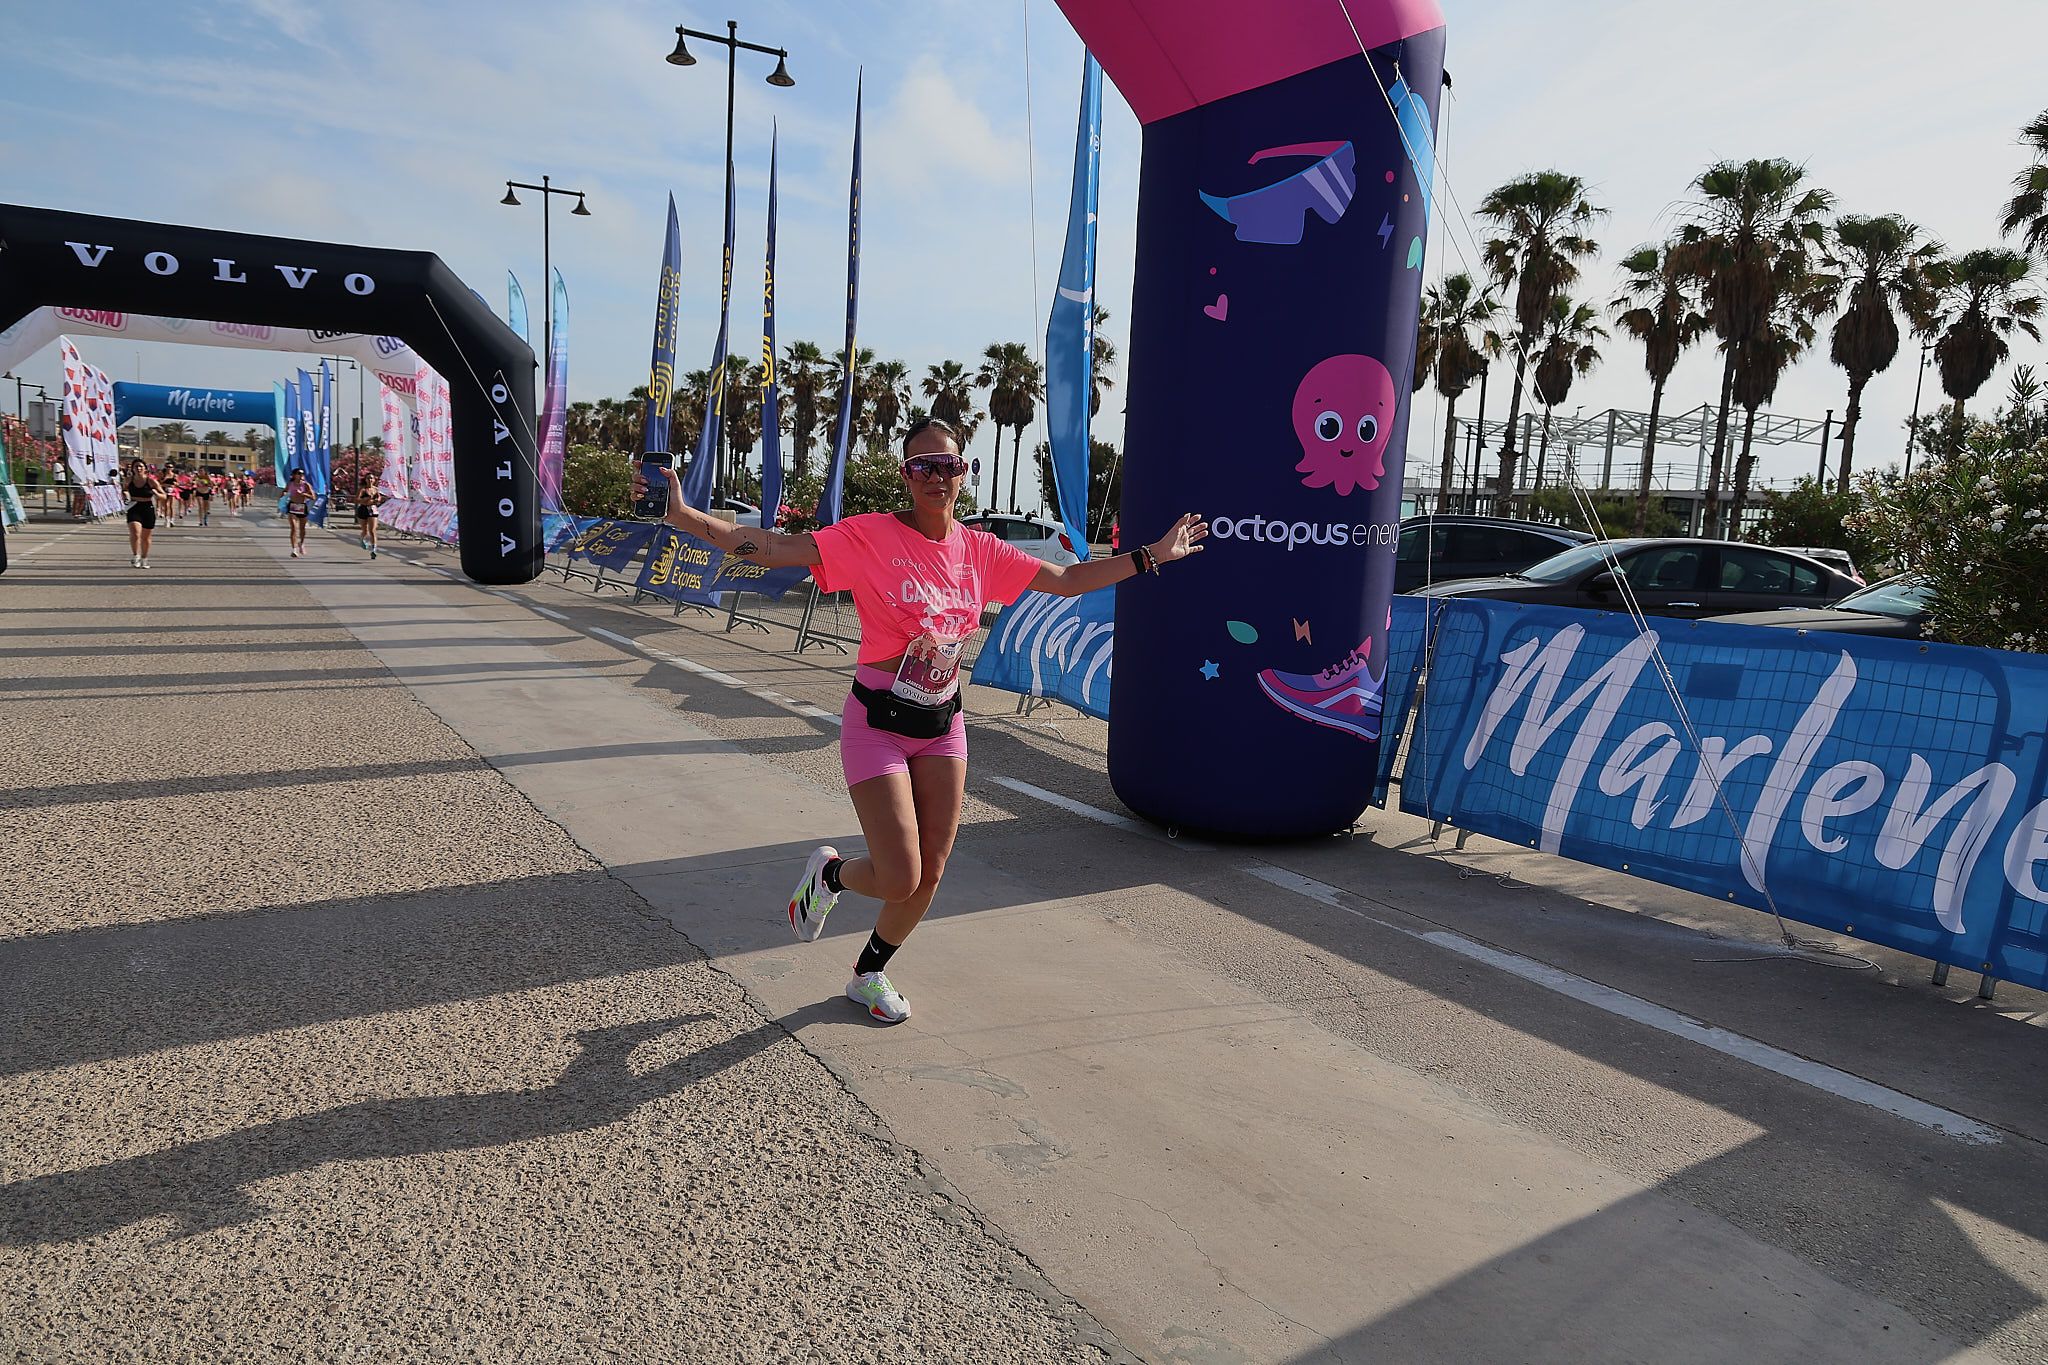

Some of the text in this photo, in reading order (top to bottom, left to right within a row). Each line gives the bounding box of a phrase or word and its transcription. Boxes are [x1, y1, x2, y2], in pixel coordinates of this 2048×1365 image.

[64, 241, 376, 295] VOLVO
[167, 389, 235, 415] Marlene
[492, 383, 516, 558] VOLVO
[1211, 514, 1349, 552] octopus
[678, 542, 711, 567] Correos
[892, 557, 927, 572] OYSO
[672, 566, 702, 591] Express
[725, 561, 771, 580] Express
[902, 687, 929, 702] OYSHO
